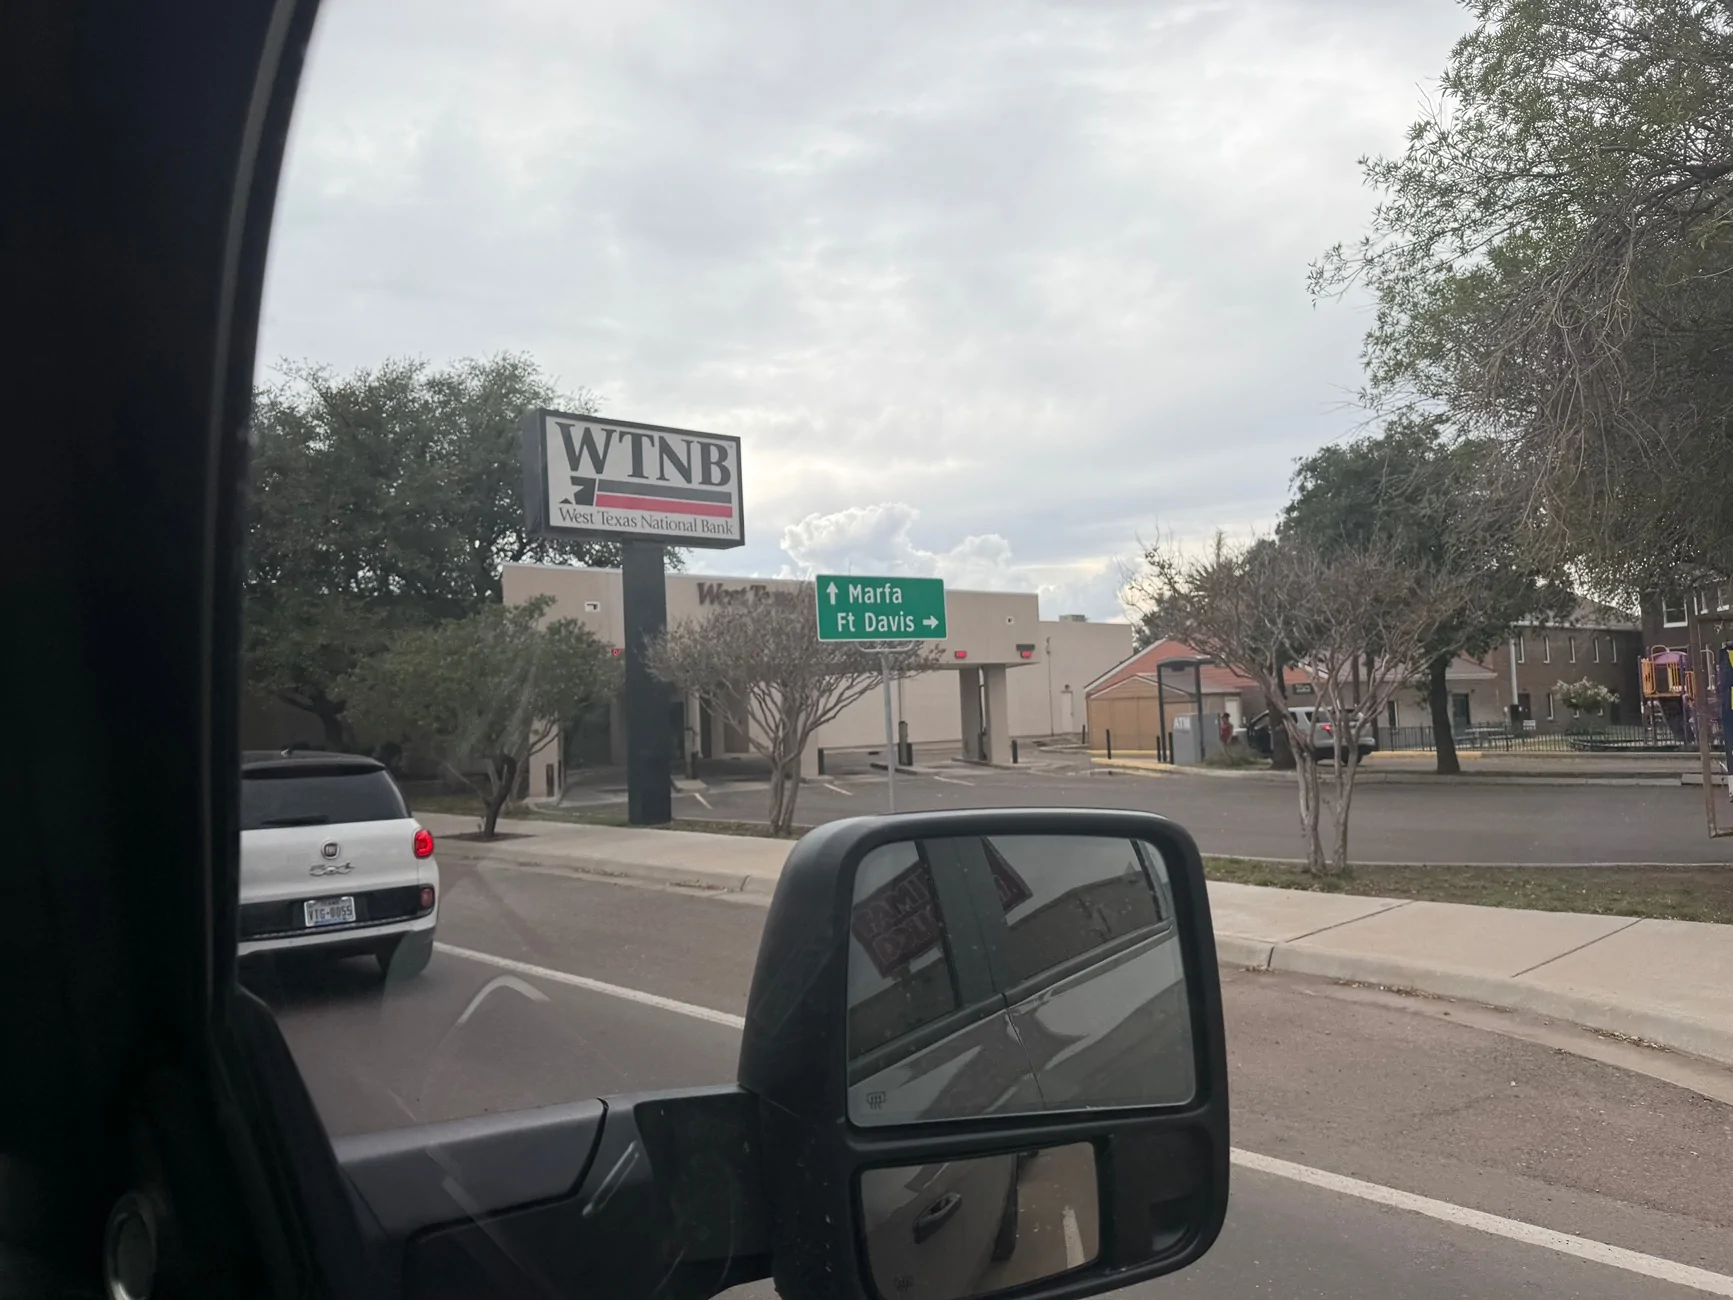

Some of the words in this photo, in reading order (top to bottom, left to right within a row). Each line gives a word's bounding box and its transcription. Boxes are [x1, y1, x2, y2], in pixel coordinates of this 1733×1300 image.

[555, 421, 731, 487] WTNB
[558, 507, 595, 525] West
[597, 510, 638, 528] Texas
[641, 514, 697, 533] National
[701, 519, 734, 535] Bank
[848, 583, 903, 604] Marfa
[837, 612, 856, 632] Ft
[865, 611, 915, 632] Davis
